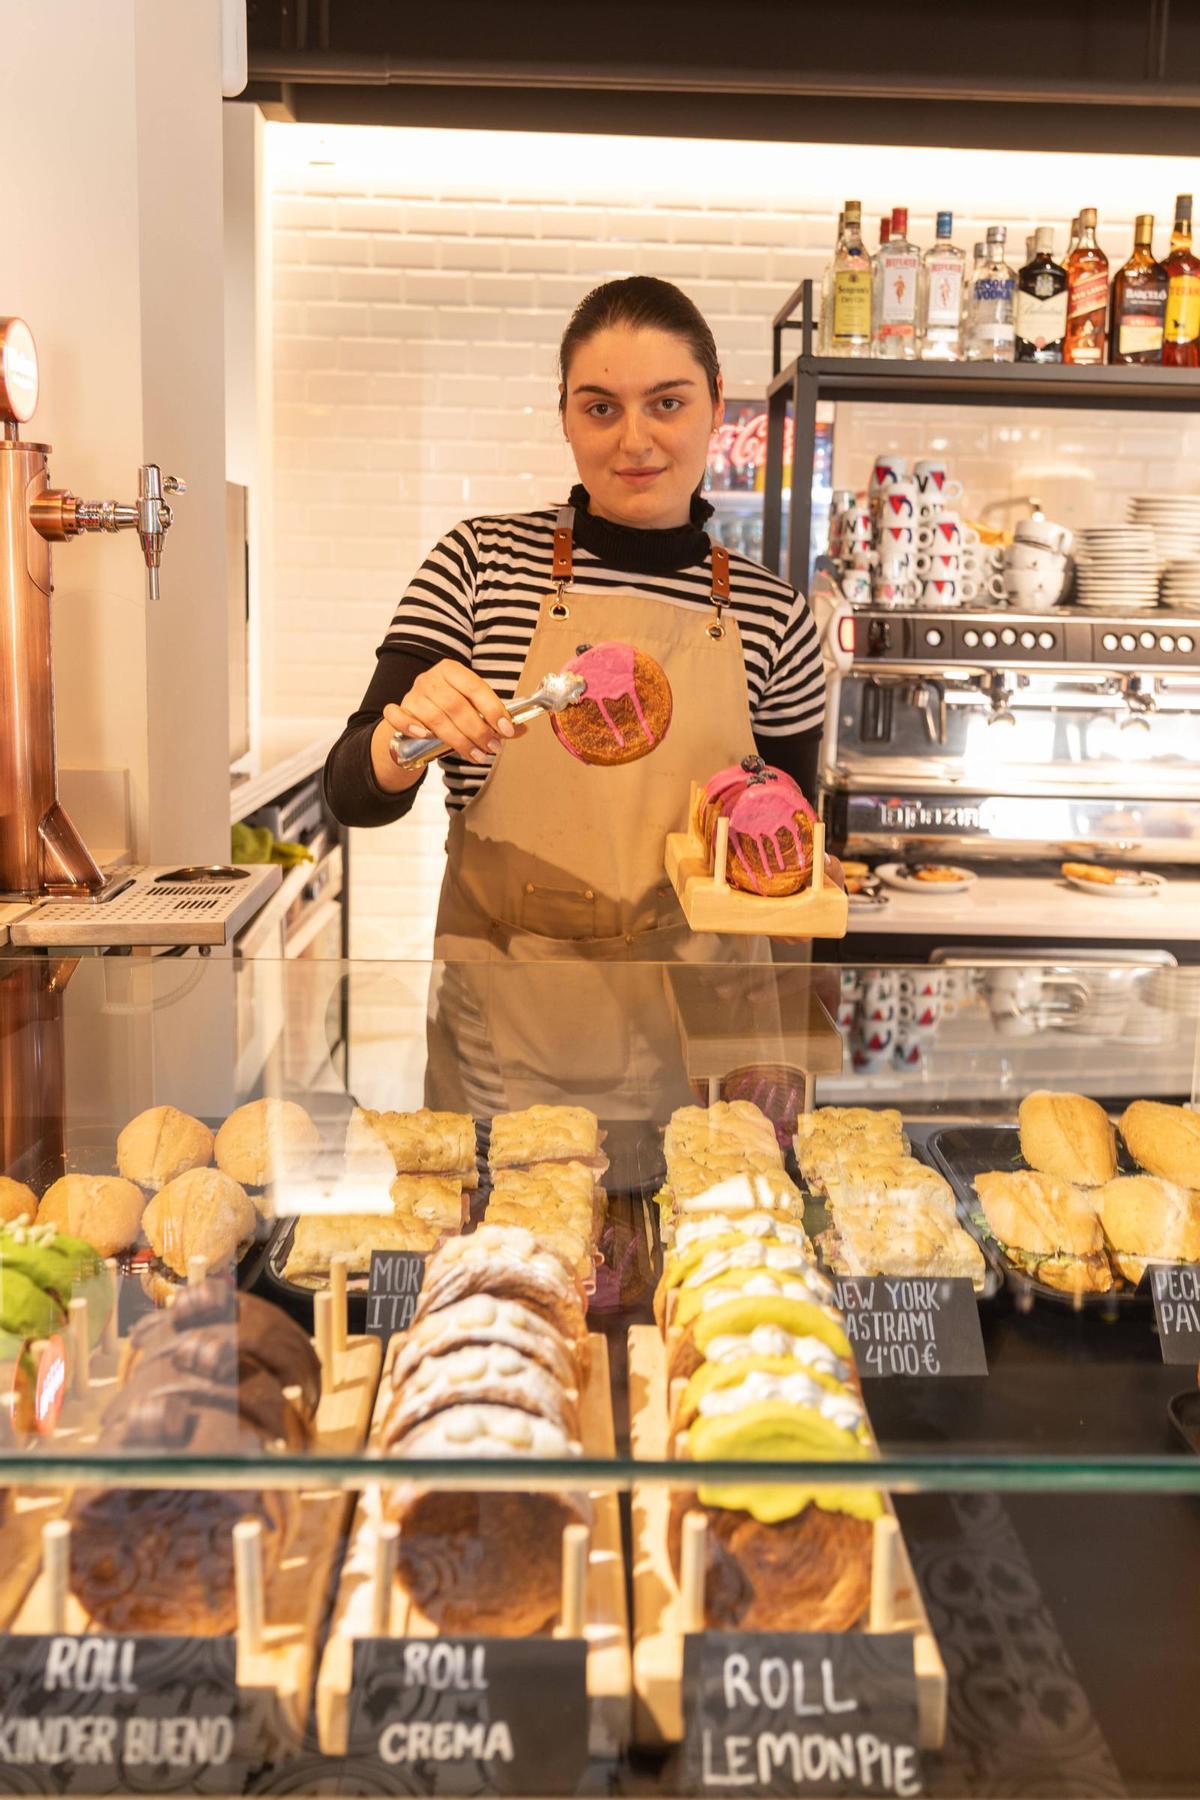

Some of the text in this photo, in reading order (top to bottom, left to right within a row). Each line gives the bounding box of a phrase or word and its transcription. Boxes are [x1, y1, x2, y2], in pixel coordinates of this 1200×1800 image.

[884, 1282, 940, 1311] YORK
[845, 1312, 936, 1342] ASTRAMI
[45, 1637, 138, 1694] ROLL
[403, 1642, 489, 1690] ROLL
[723, 1652, 859, 1716] ROLL
[123, 1715, 235, 1766] BUENO
[378, 1720, 515, 1764] CREMA
[702, 1729, 923, 1797] LEMONPIE
